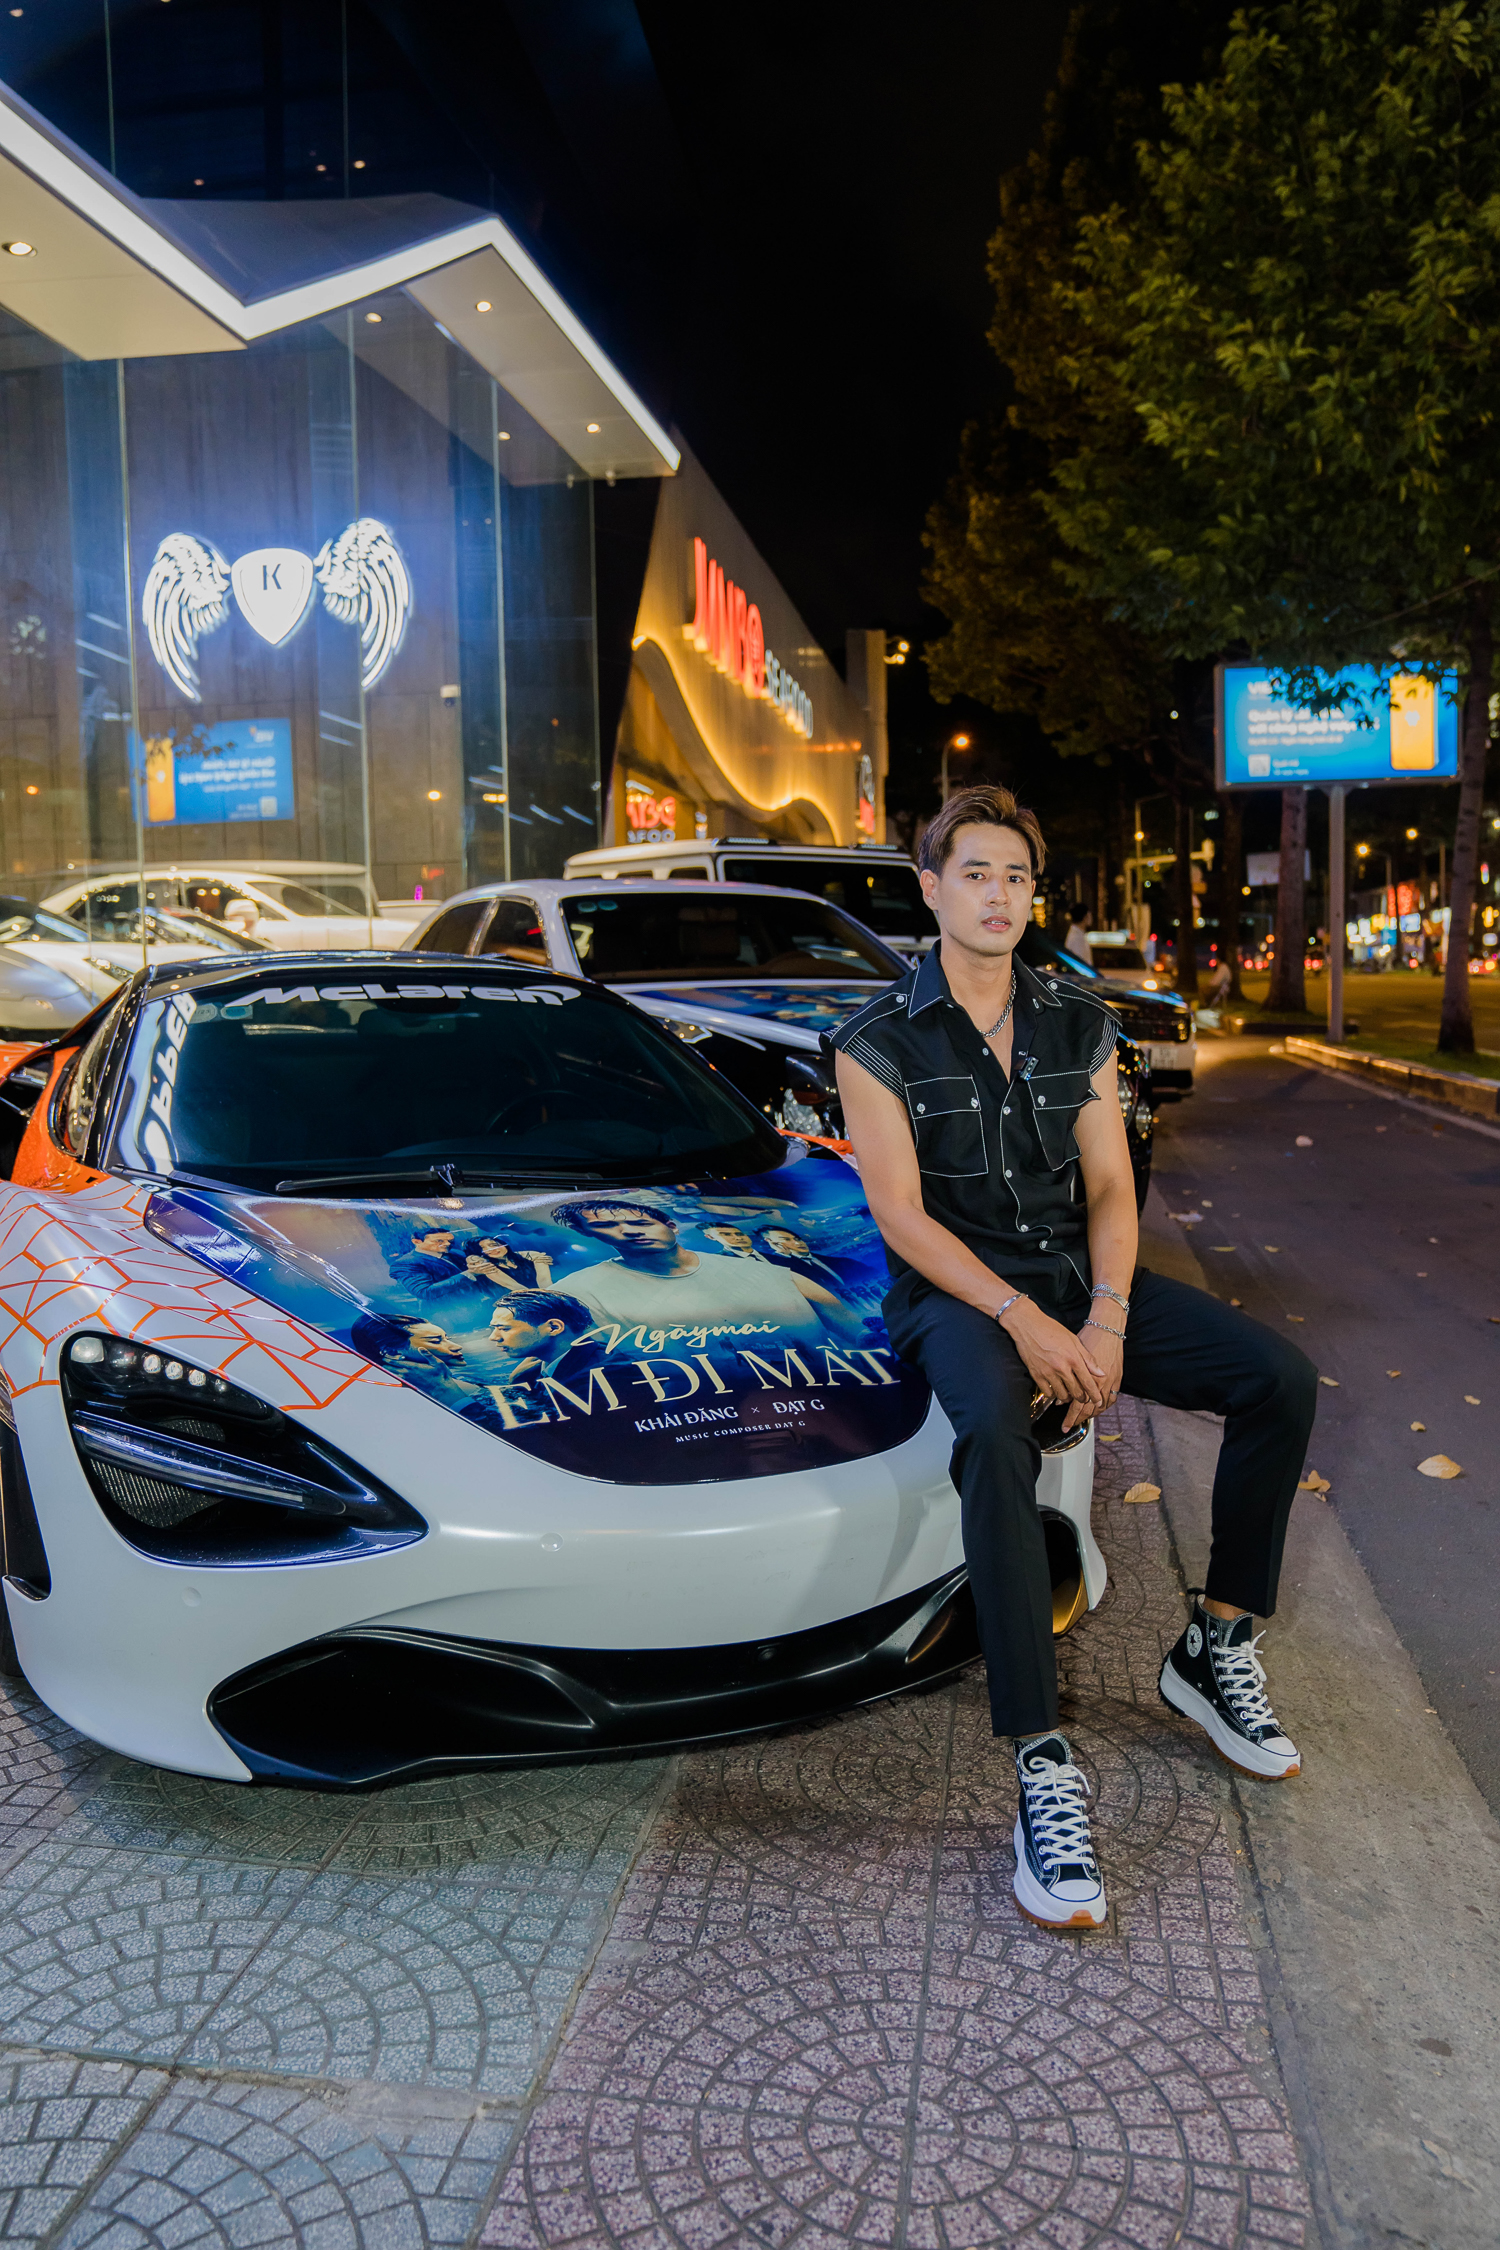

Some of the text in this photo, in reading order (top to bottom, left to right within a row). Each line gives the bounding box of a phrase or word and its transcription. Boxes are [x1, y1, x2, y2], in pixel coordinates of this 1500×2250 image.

[262, 563, 282, 591] K
[224, 983, 581, 1006] McLaren
[483, 1366, 627, 1430] EM
[632, 1353, 733, 1403] ĐI
[684, 1406, 739, 1425] ĐĂNG
[772, 1399, 806, 1416] ĐẠT
[810, 1398, 825, 1411] G
[675, 1431, 710, 1443] MUSIC
[713, 1423, 771, 1437] COMPOSER
